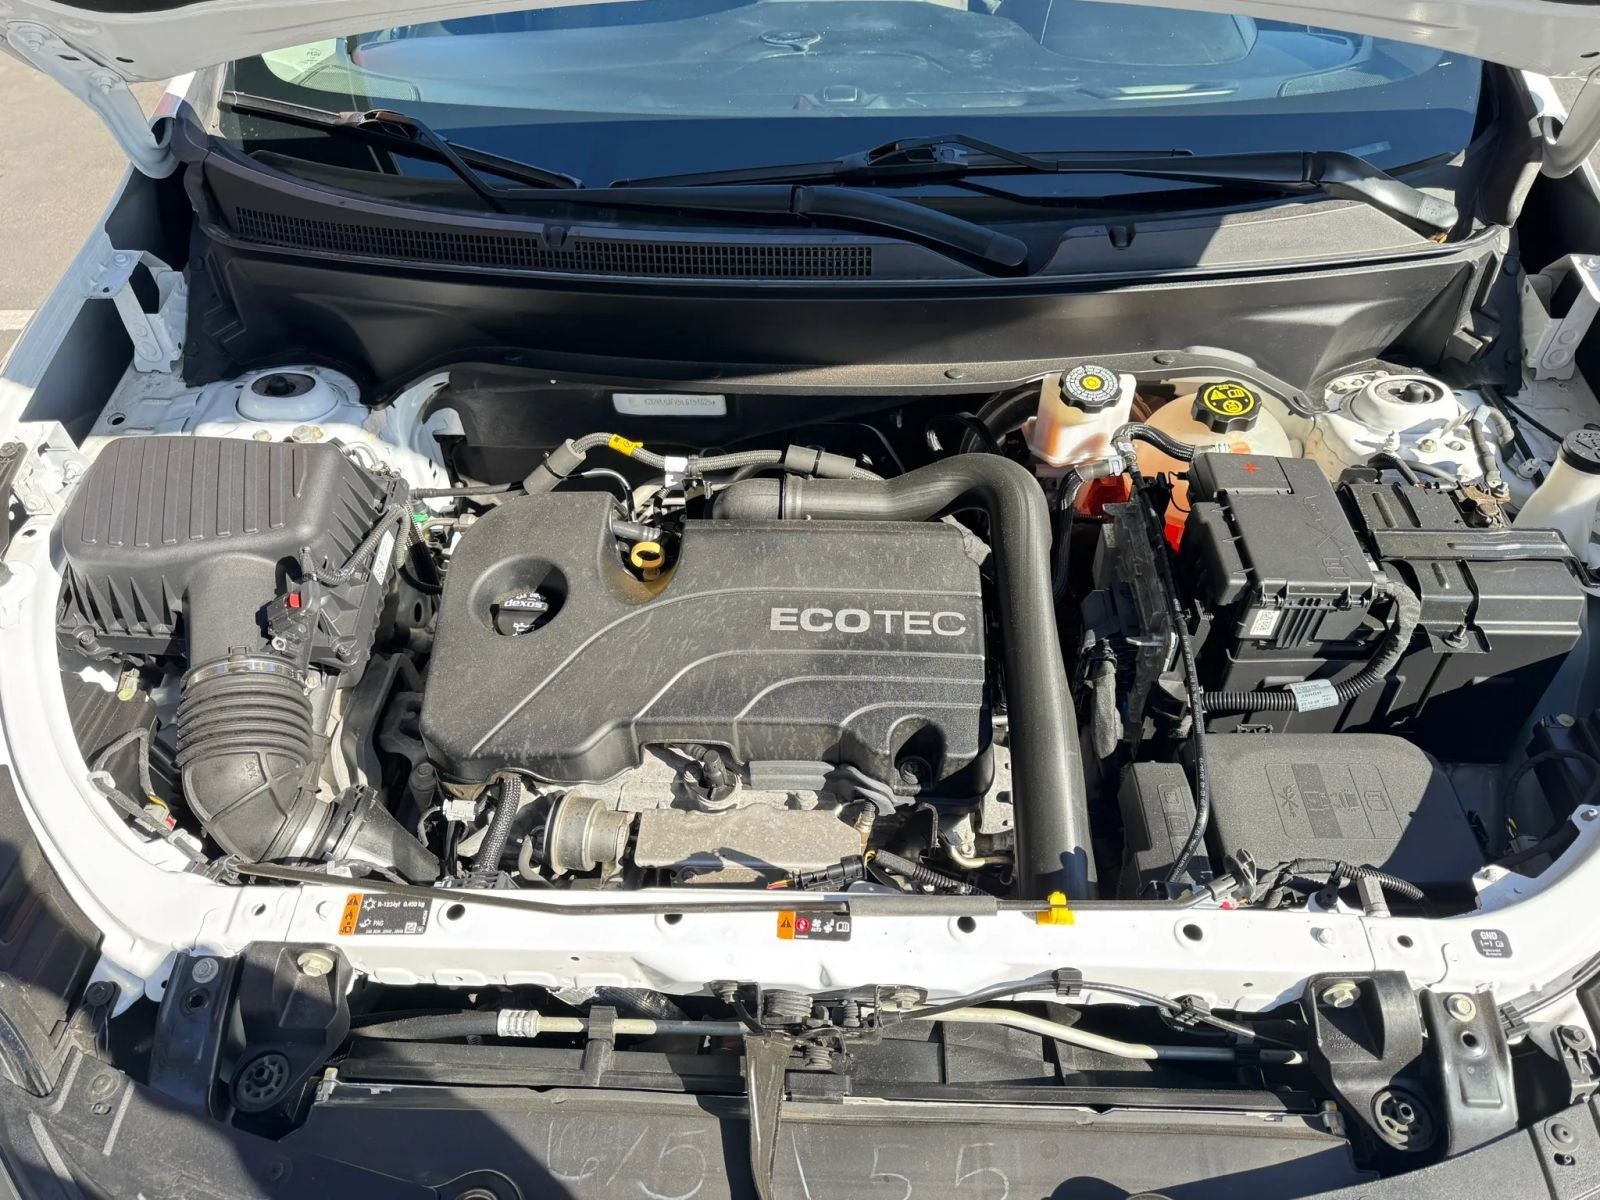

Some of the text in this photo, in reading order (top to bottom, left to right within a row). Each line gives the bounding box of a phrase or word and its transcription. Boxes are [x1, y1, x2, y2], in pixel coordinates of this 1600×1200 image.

[503, 599, 544, 609] dexos
[770, 607, 966, 636] ECOTEC
[1480, 931, 1498, 940] GND
